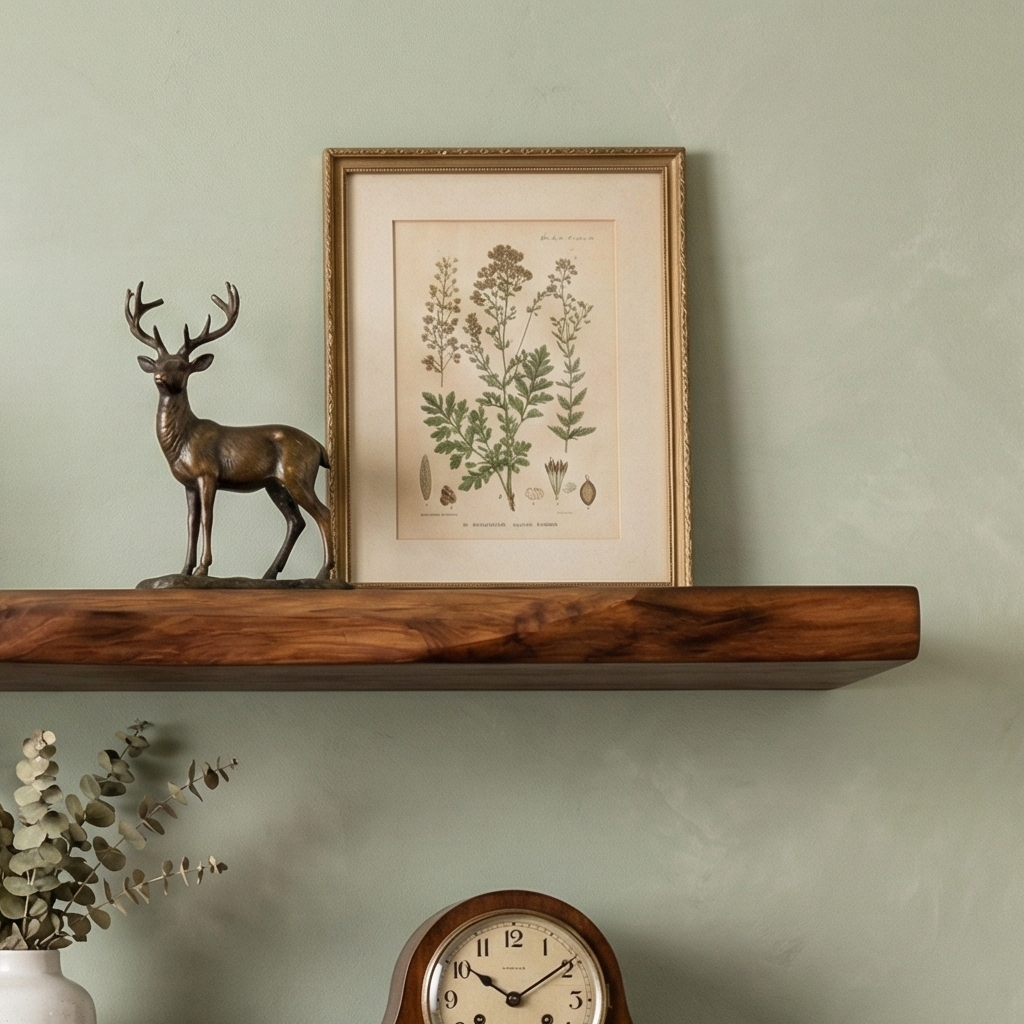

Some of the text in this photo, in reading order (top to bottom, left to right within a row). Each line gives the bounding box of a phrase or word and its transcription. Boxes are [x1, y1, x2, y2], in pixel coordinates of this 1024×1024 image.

[477, 938, 489, 957] 11
[505, 929, 523, 948] 12
[542, 938, 548, 956] 1
[453, 960, 471, 979] 10
[561, 959, 574, 978] 2
[444, 990, 458, 1009] 9
[569, 991, 583, 1010] 3
